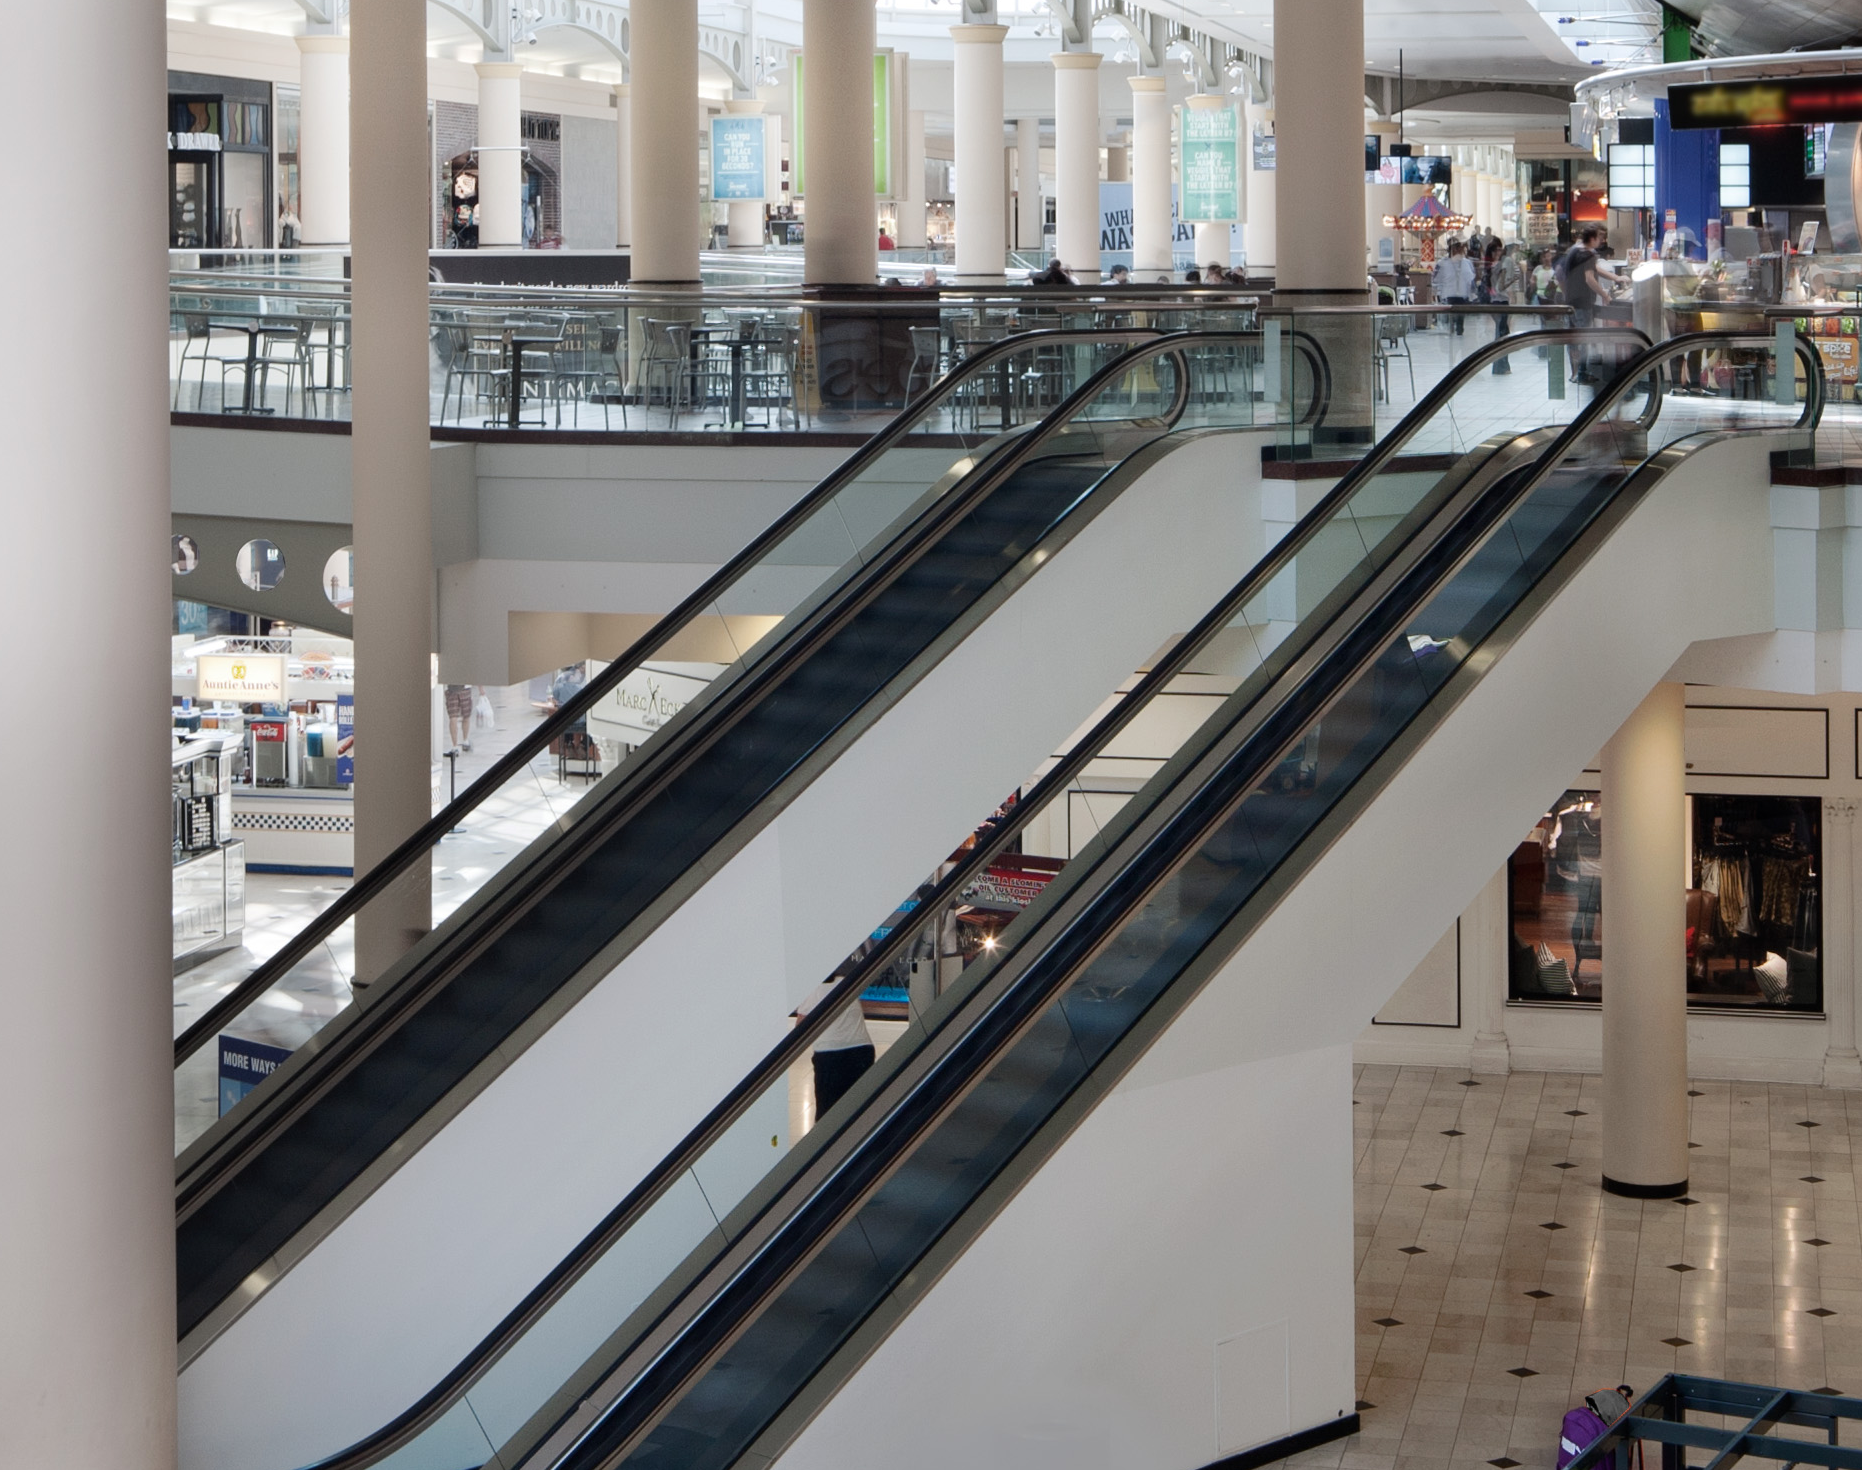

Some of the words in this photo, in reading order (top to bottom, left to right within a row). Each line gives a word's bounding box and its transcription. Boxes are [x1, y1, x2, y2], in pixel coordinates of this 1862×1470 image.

[591, 280, 629, 291] wardro
[203, 679, 238, 690] Auntie
[240, 679, 279, 690] Anne's
[223, 1050, 249, 1070] MORE
[250, 1056, 277, 1075] WAYS
